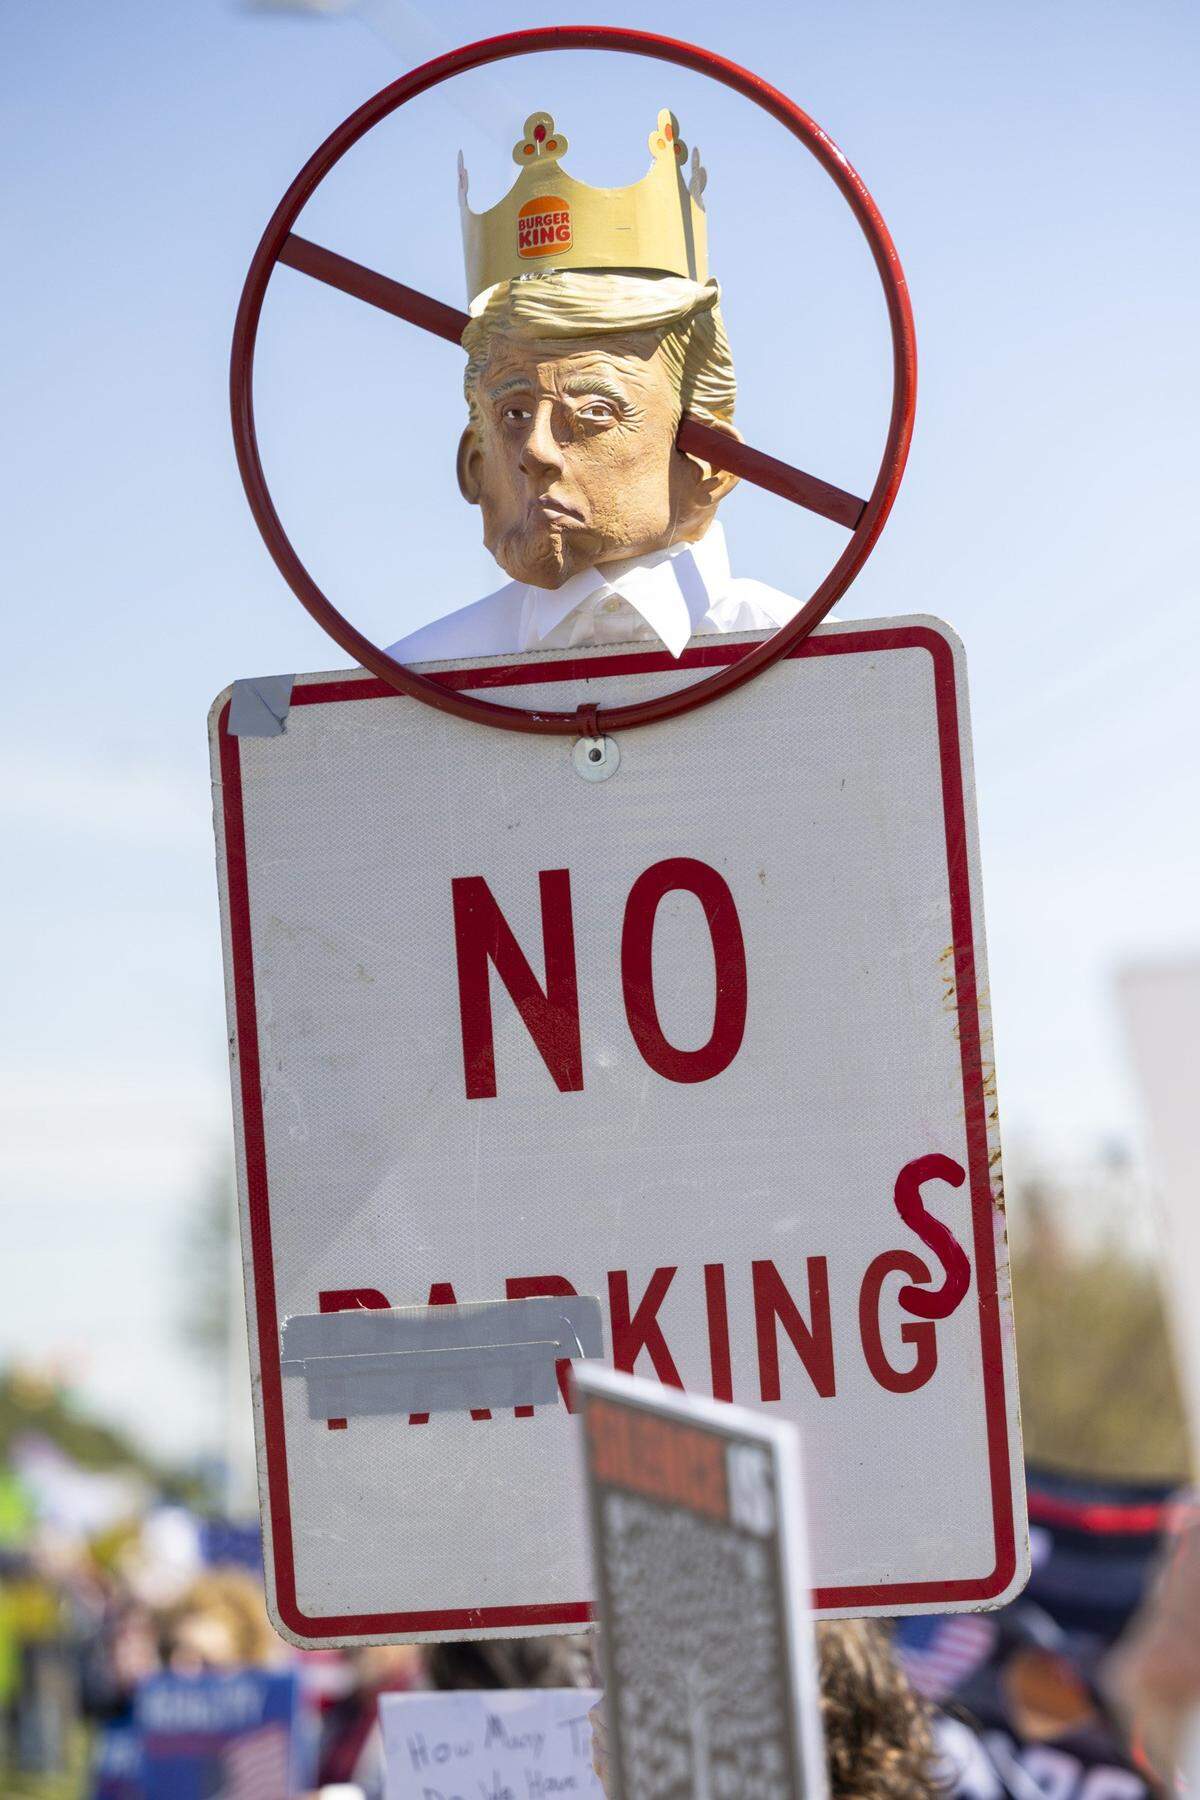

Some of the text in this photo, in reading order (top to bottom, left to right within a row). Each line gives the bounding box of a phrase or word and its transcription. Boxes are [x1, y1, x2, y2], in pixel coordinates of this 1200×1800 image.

[519, 212, 569, 231] BURGER
[519, 225, 570, 248] KING
[451, 857, 747, 1099] NO
[318, 1153, 970, 1430] KINGS
